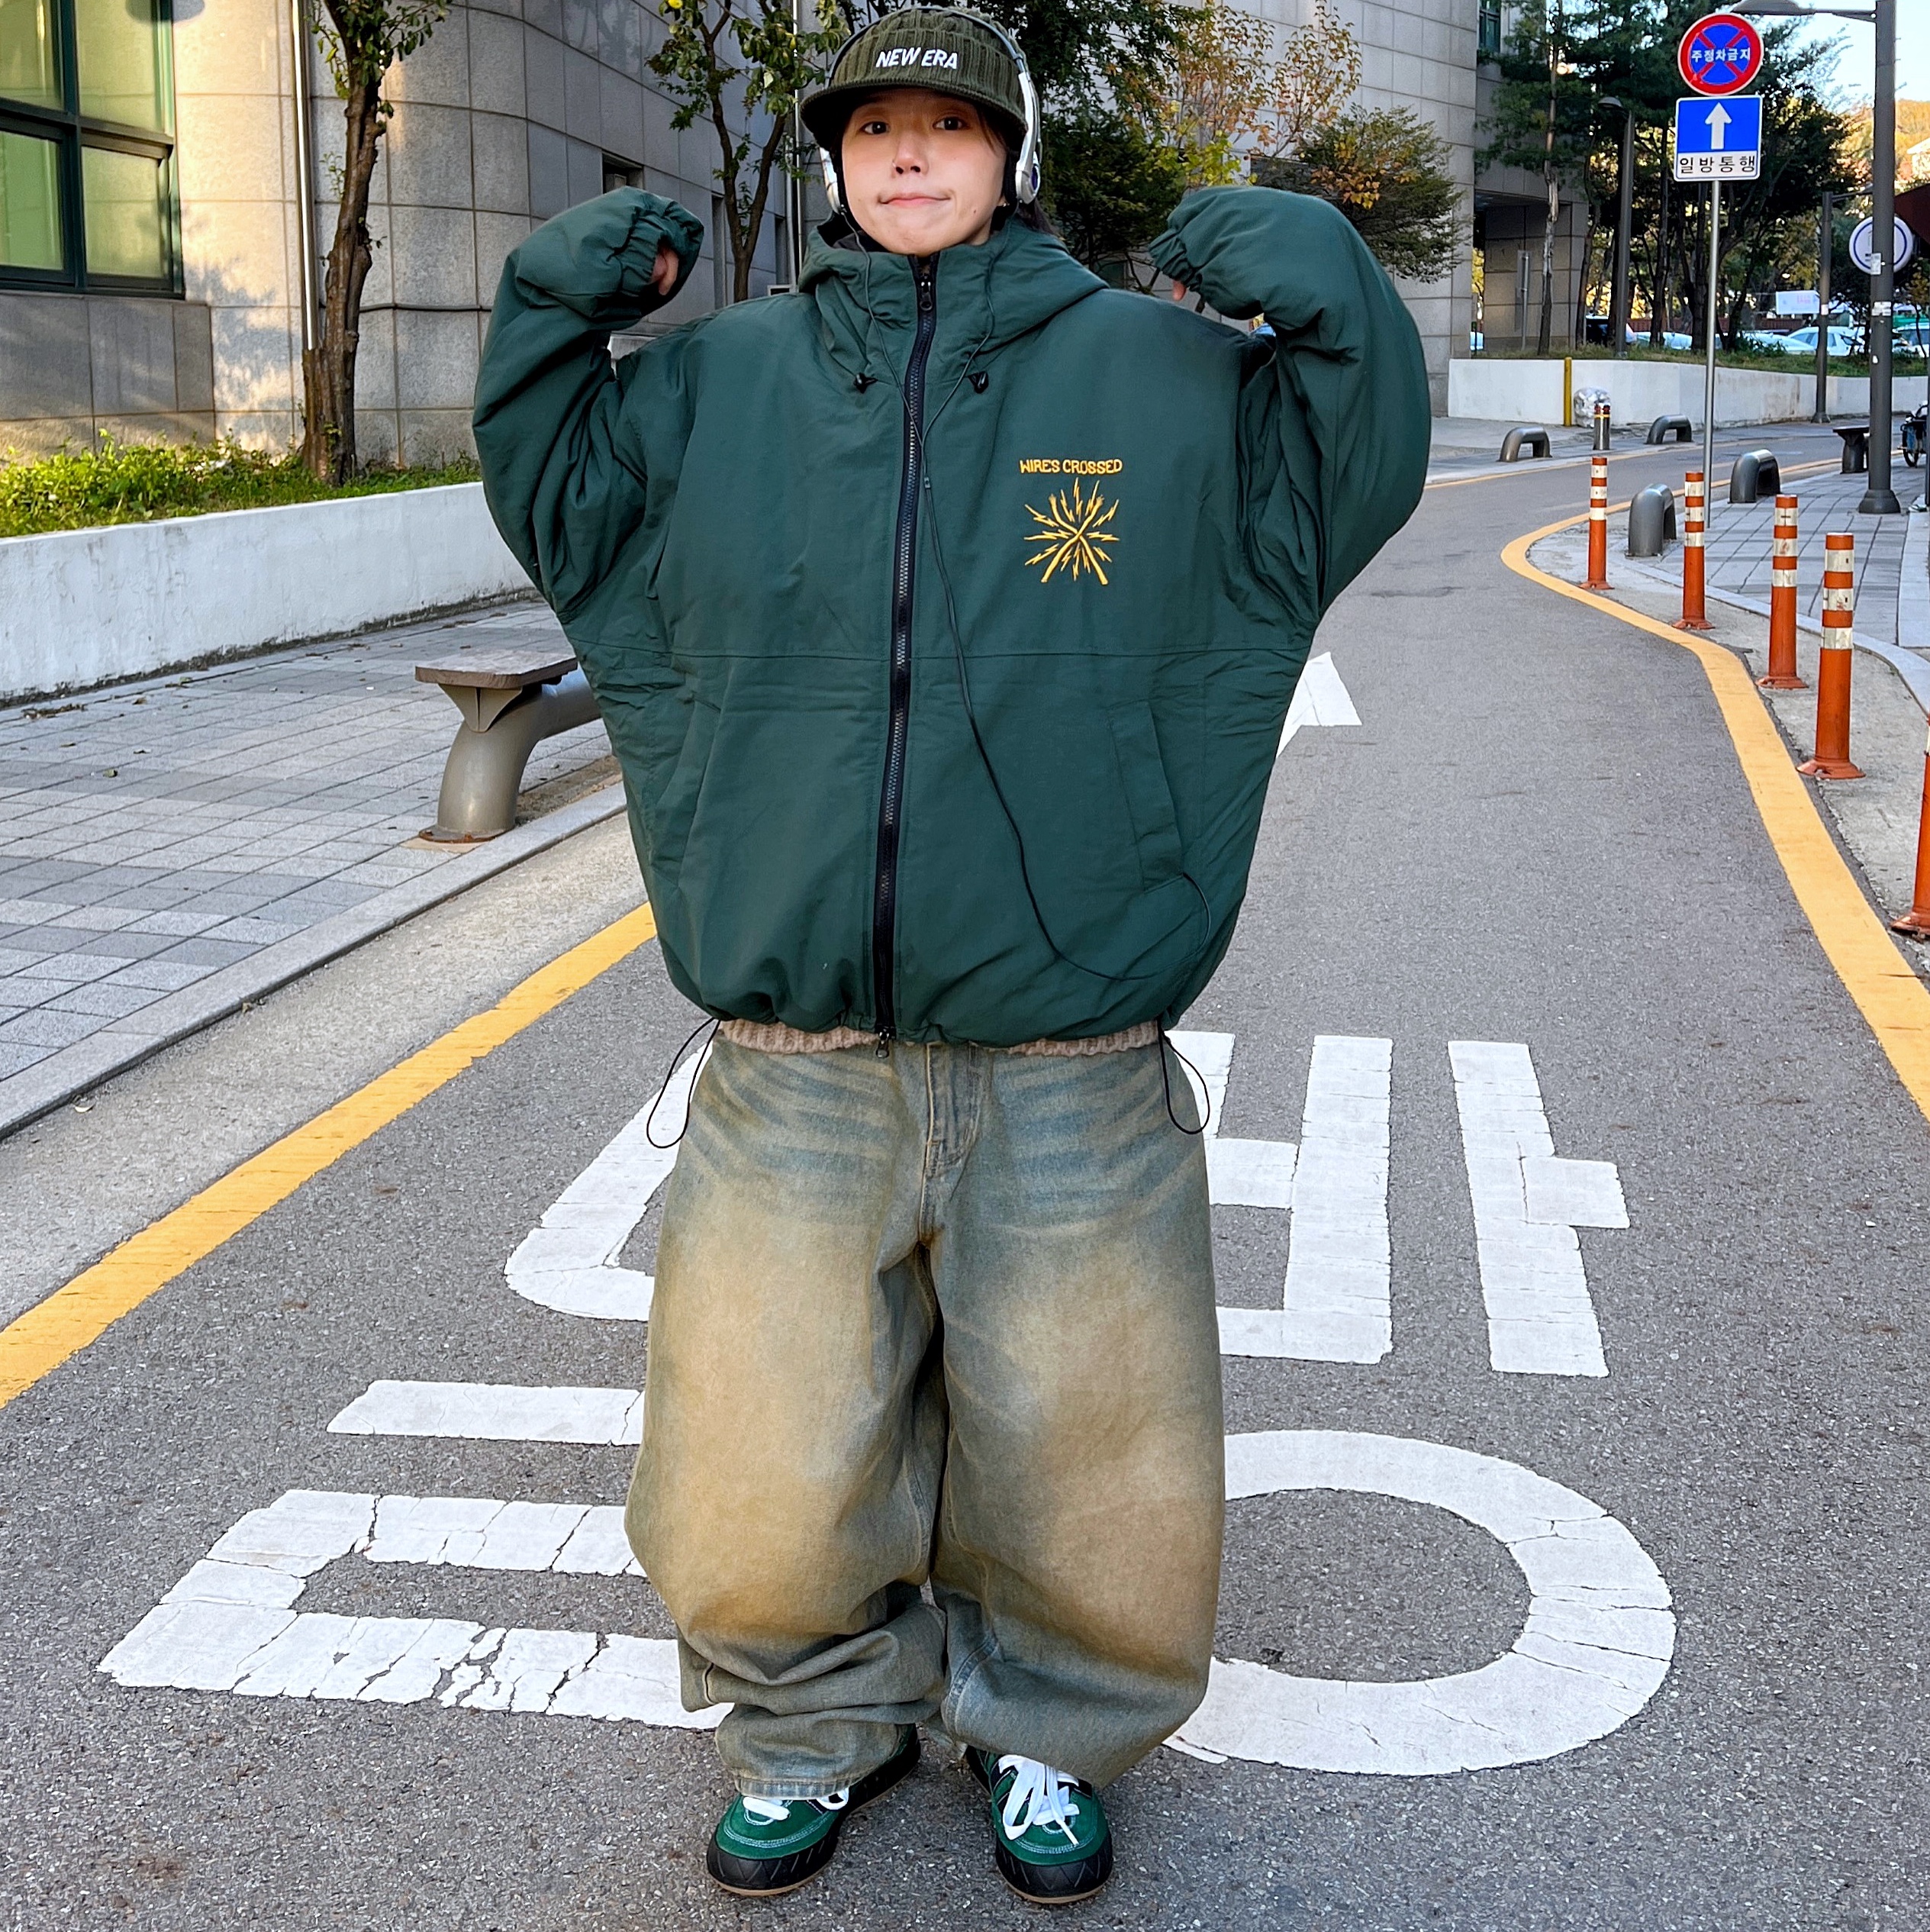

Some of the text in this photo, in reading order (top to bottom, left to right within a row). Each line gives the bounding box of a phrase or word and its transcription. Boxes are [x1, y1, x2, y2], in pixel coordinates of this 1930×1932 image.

[876, 47, 959, 69] NEW ERA
[1691, 47, 1751, 63] 주정차금지
[1680, 155, 1755, 174] 일방통행
[1020, 459, 1123, 475] WIRES CROSSED
